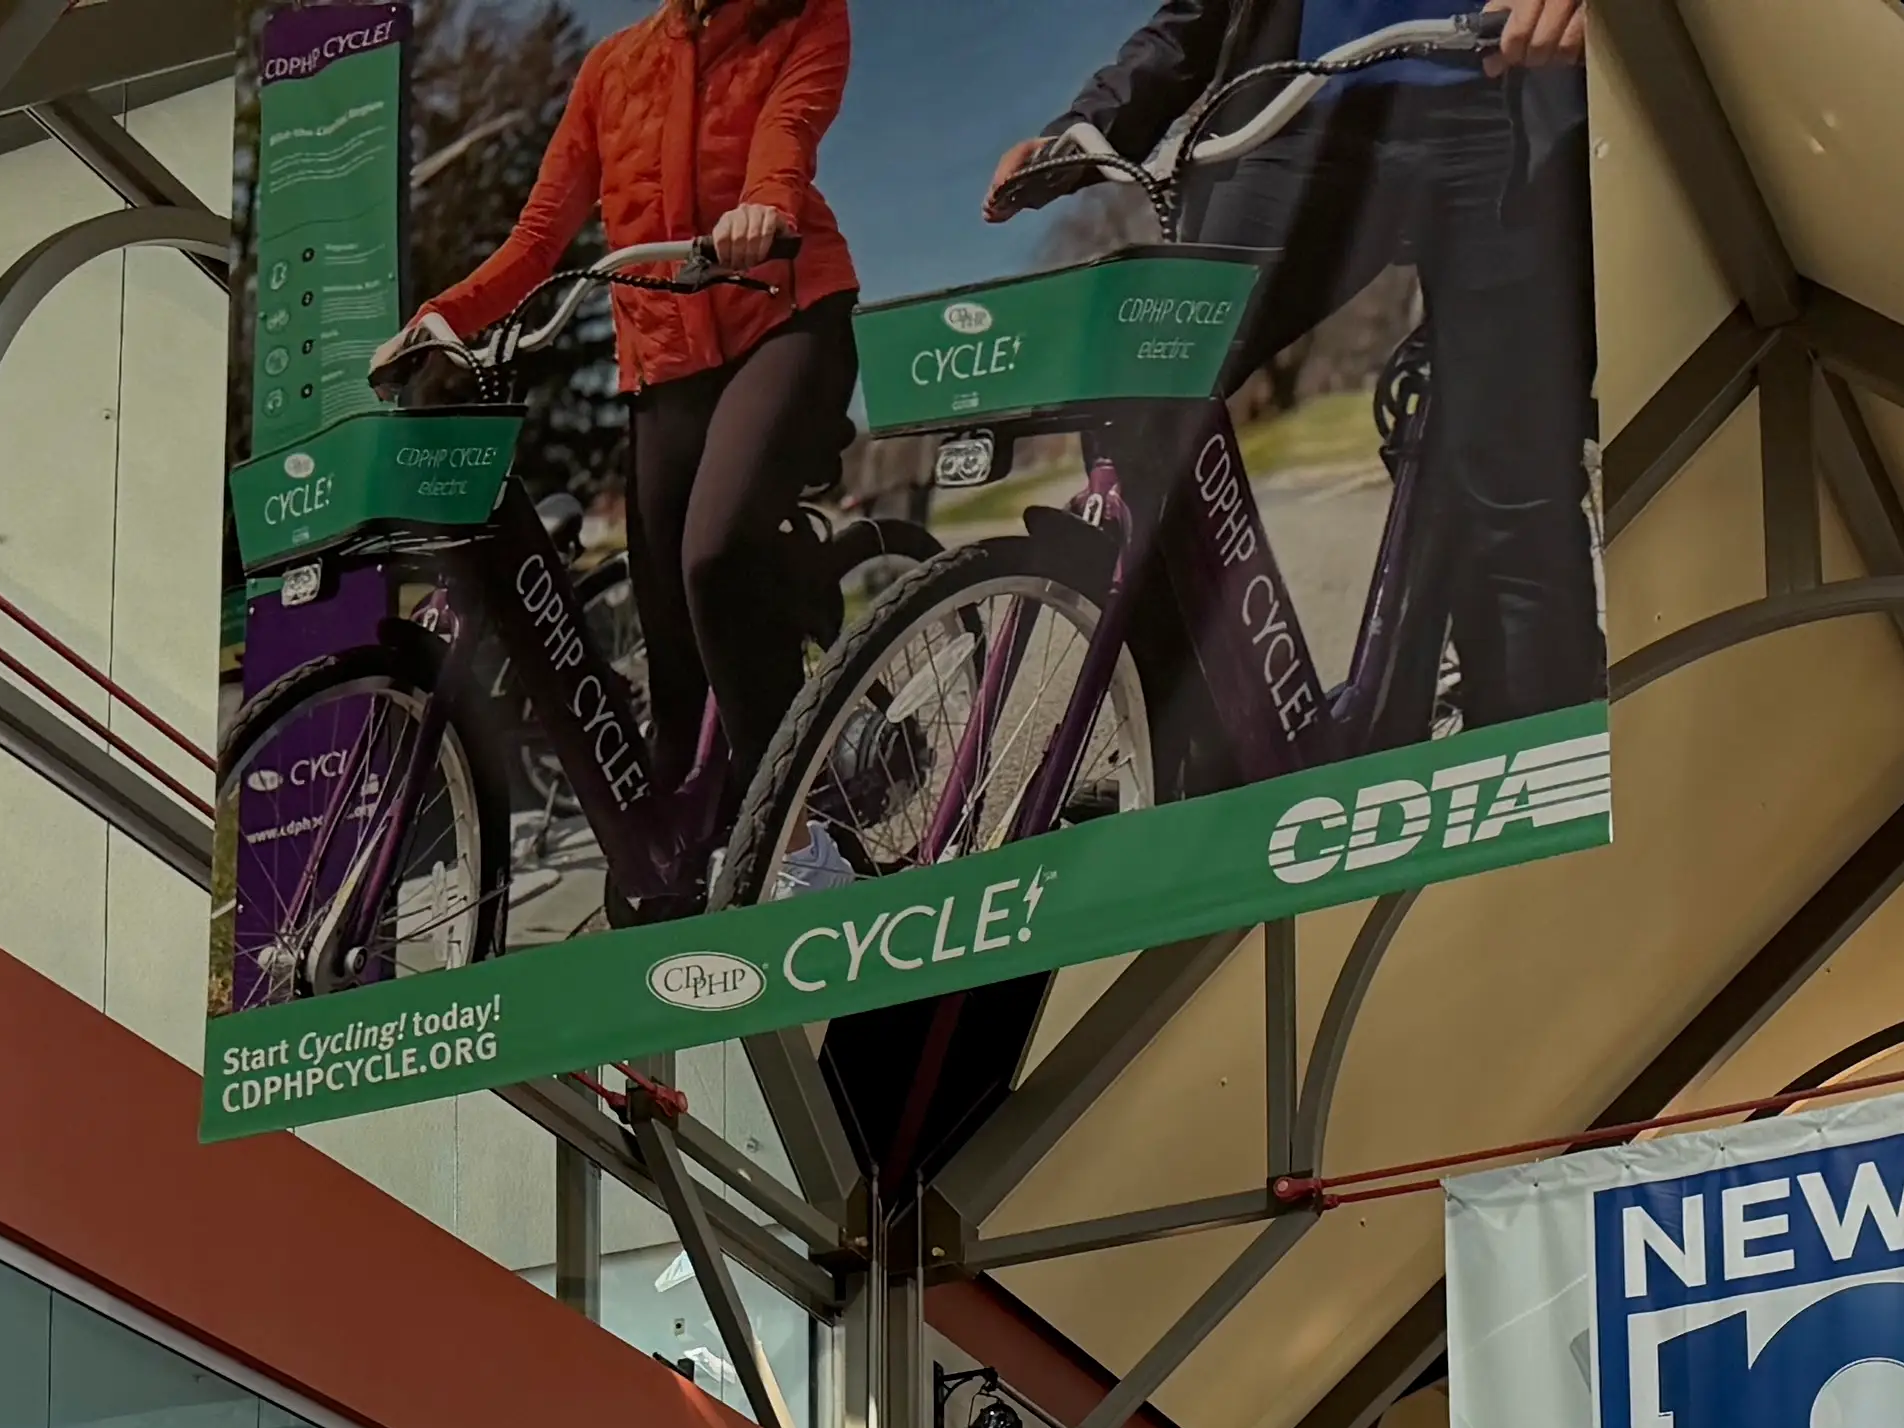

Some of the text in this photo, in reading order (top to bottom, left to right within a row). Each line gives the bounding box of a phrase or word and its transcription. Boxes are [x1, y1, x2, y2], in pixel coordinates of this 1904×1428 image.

[264, 19, 395, 79] CDPHP CYCLE!
[1119, 298, 1175, 324] CDPHP
[911, 331, 1025, 386] CYCLE!
[1137, 337, 1196, 360] electric
[396, 447, 449, 468] CDPHP
[263, 472, 335, 526] CYCLE!
[1194, 433, 1316, 742] CDPHP CYCLE!
[514, 553, 651, 812] CDPHP CYCLE!
[1266, 731, 1611, 884] CDTA
[662, 866, 1046, 1000] CDPHP CYCLE!
[222, 993, 502, 1077] Start Cycling! today!
[221, 1031, 499, 1115] CDPHPCYCLE.ORG
